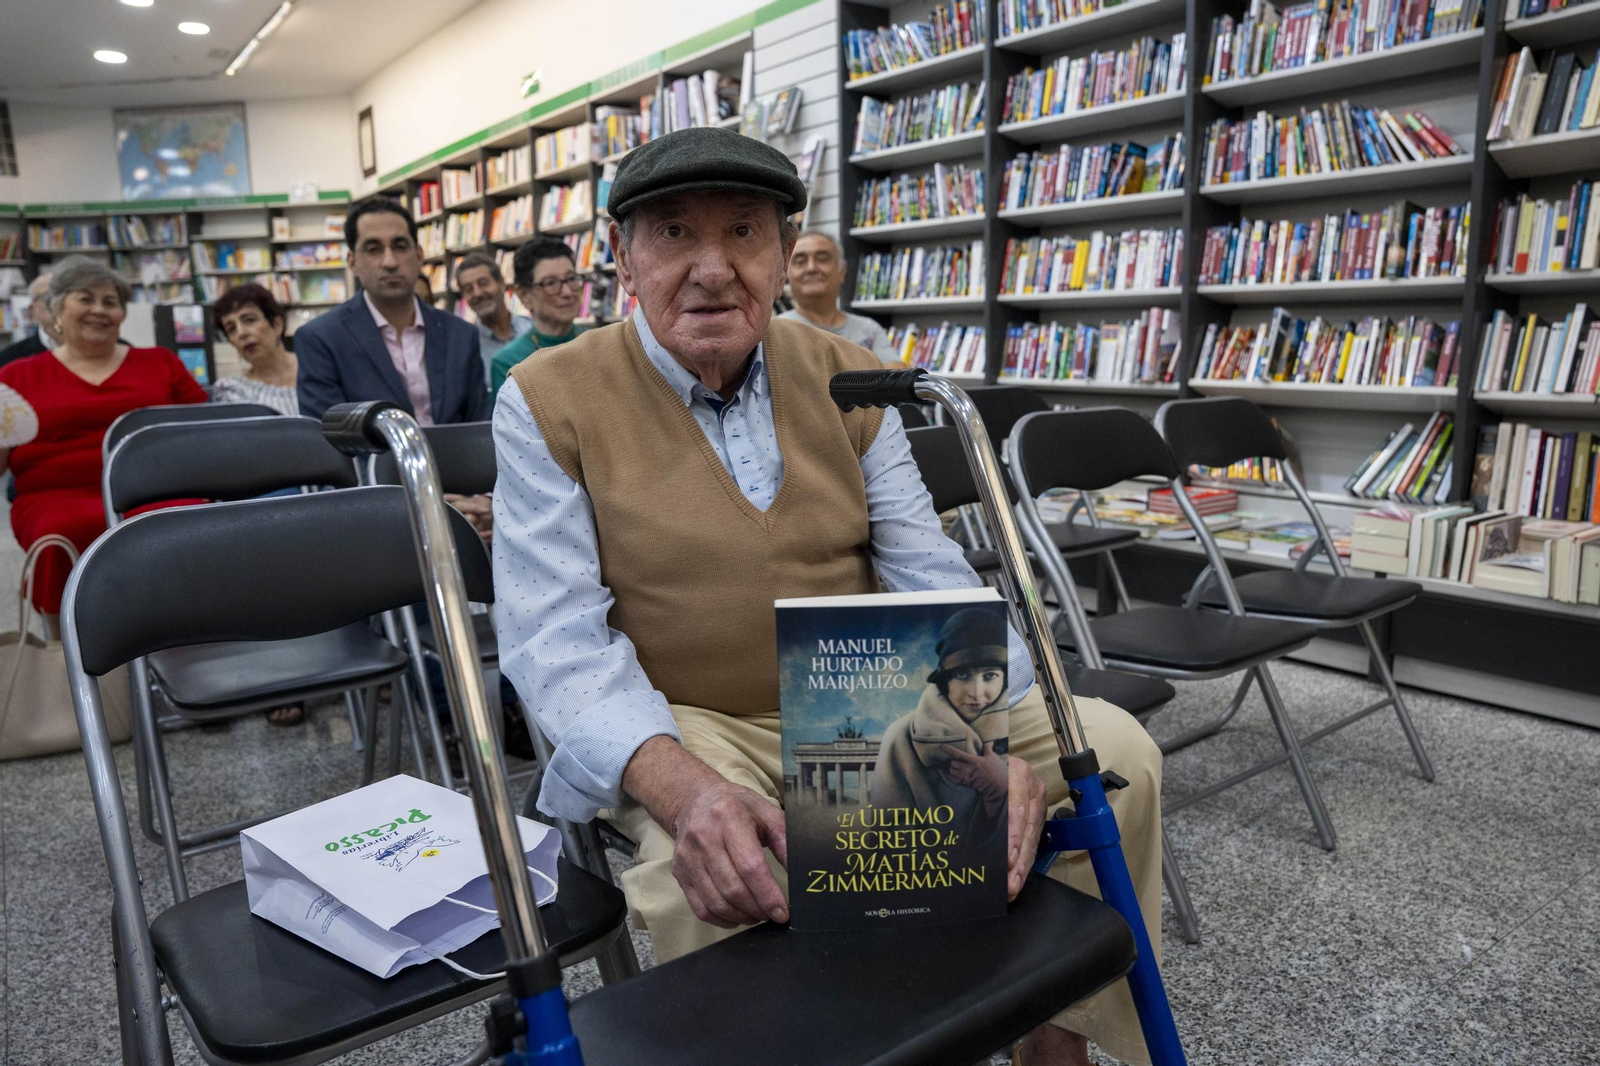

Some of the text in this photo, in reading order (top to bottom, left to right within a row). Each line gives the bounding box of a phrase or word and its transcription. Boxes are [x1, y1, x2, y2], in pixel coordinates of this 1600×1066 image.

[817, 638, 896, 655] MANUEL
[811, 656, 903, 672] HURTADO
[808, 673, 908, 692] MARJALIZO
[837, 804, 955, 828] El ÚLTIMO
[324, 808, 433, 852] Picasso
[835, 828, 960, 850] SECRETO de
[843, 849, 949, 875] MATÍAS
[805, 865, 986, 893] ZIMMERMANN
